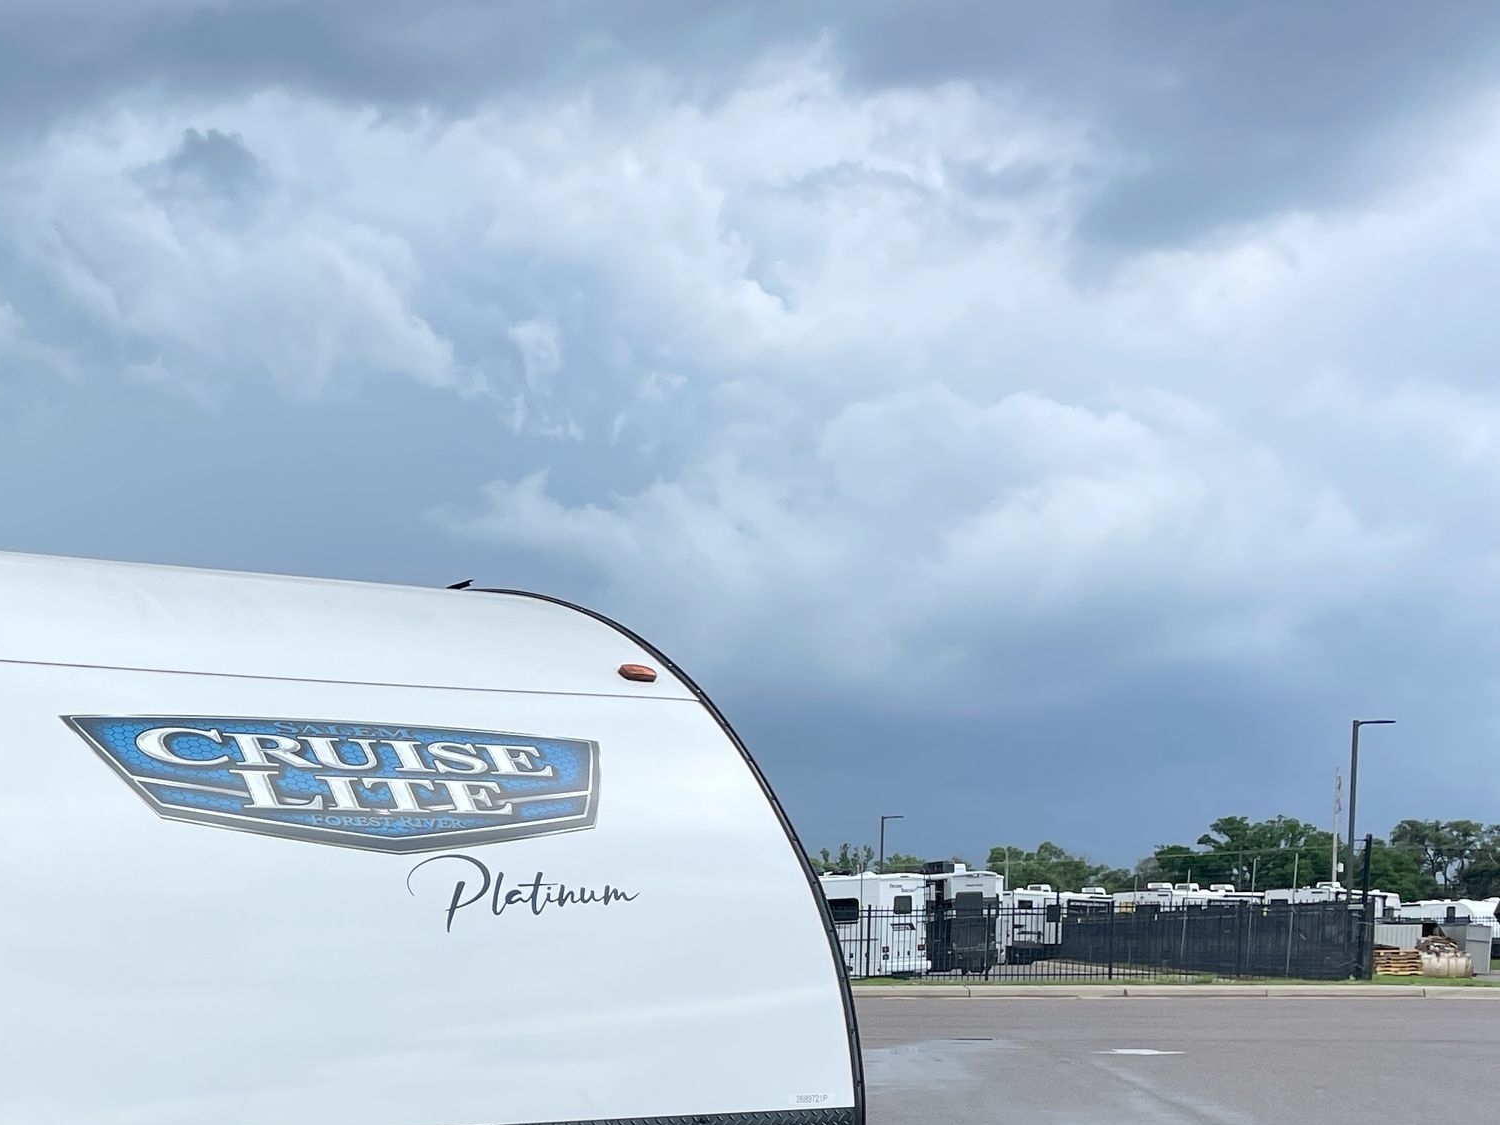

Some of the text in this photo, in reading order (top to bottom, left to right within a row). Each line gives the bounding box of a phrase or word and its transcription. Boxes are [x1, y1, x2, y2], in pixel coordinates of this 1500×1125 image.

[135, 727, 553, 777] CRUISE
[273, 721, 415, 740] SALEM
[228, 769, 513, 815] LITE
[311, 814, 467, 829] FOREST RIVER
[406, 854, 640, 934] Platinum
